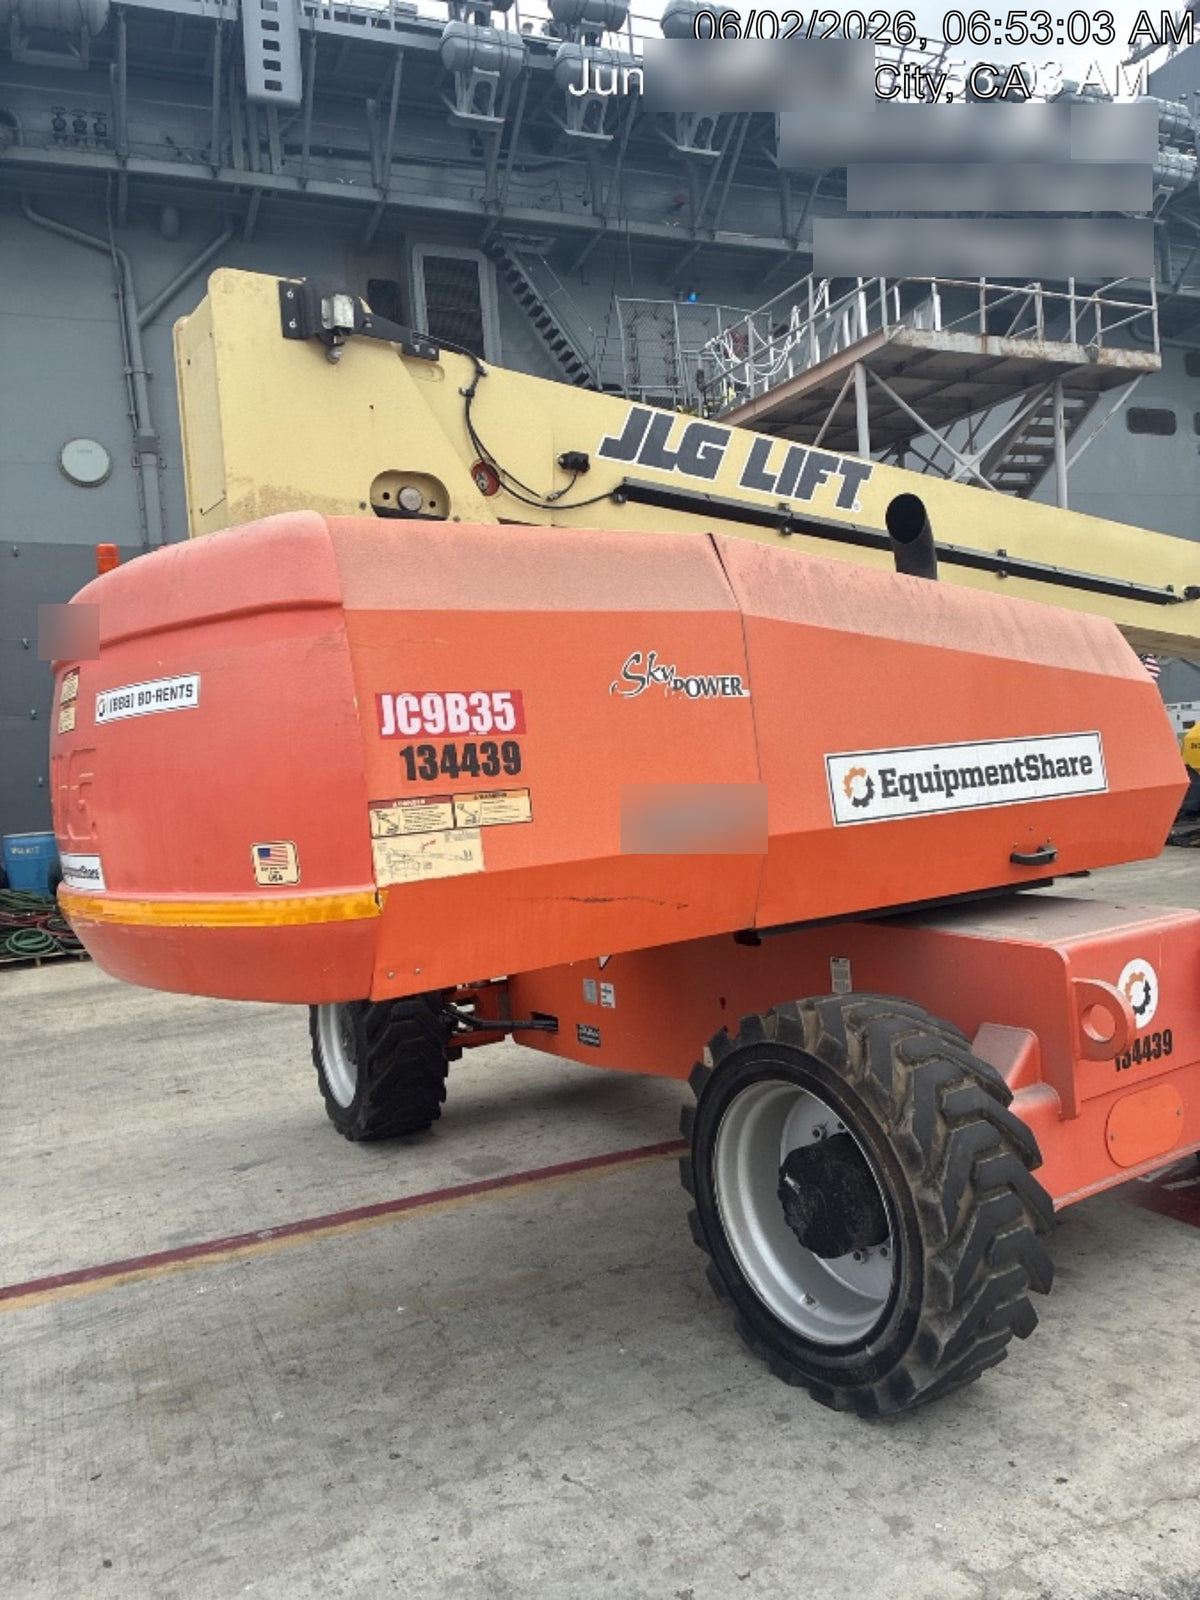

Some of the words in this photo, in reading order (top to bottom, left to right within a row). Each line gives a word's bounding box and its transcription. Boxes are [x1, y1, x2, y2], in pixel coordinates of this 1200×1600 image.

[596, 405, 733, 481] JLG
[737, 434, 875, 510] LIFT
[380, 691, 517, 736] JC9B35
[399, 740, 522, 781] 134439
[877, 752, 1093, 803] EquipmentShare
